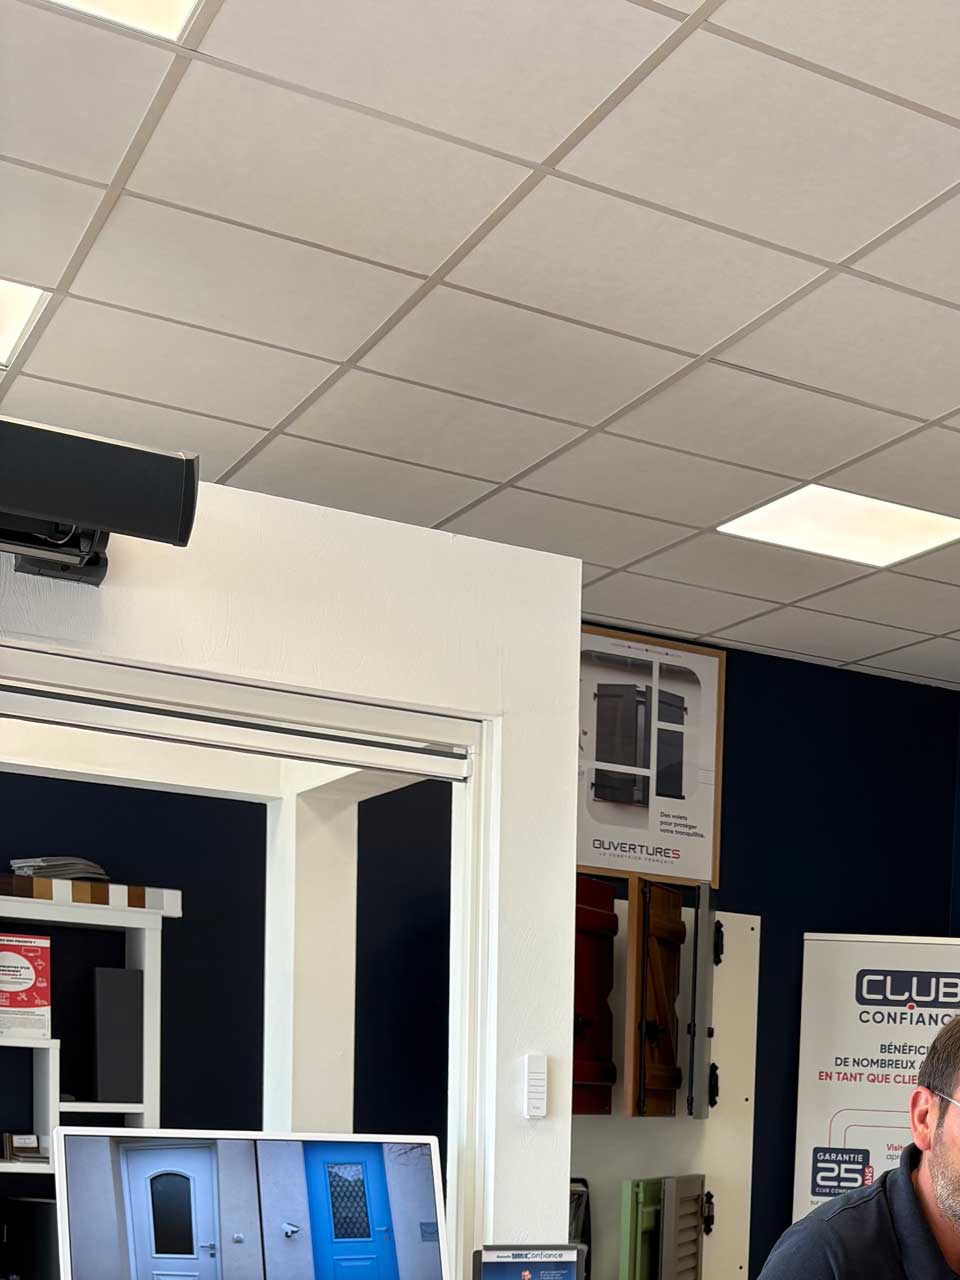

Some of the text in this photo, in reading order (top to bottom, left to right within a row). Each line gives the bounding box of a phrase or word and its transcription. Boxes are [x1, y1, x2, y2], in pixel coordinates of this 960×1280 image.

[592, 838, 681, 859] OUVERTURES
[858, 1010, 960, 1026] CONFIANC
[834, 1056, 850, 1067] DE
[852, 1057, 916, 1070] NOMBREUX
[818, 1071, 833, 1081] EN
[835, 1071, 864, 1083] TANT
[866, 1072, 891, 1083] QUE
[816, 1152, 864, 1162] GARANTIE
[816, 1162, 863, 1188] 25
[864, 1167, 873, 1186] ANS
